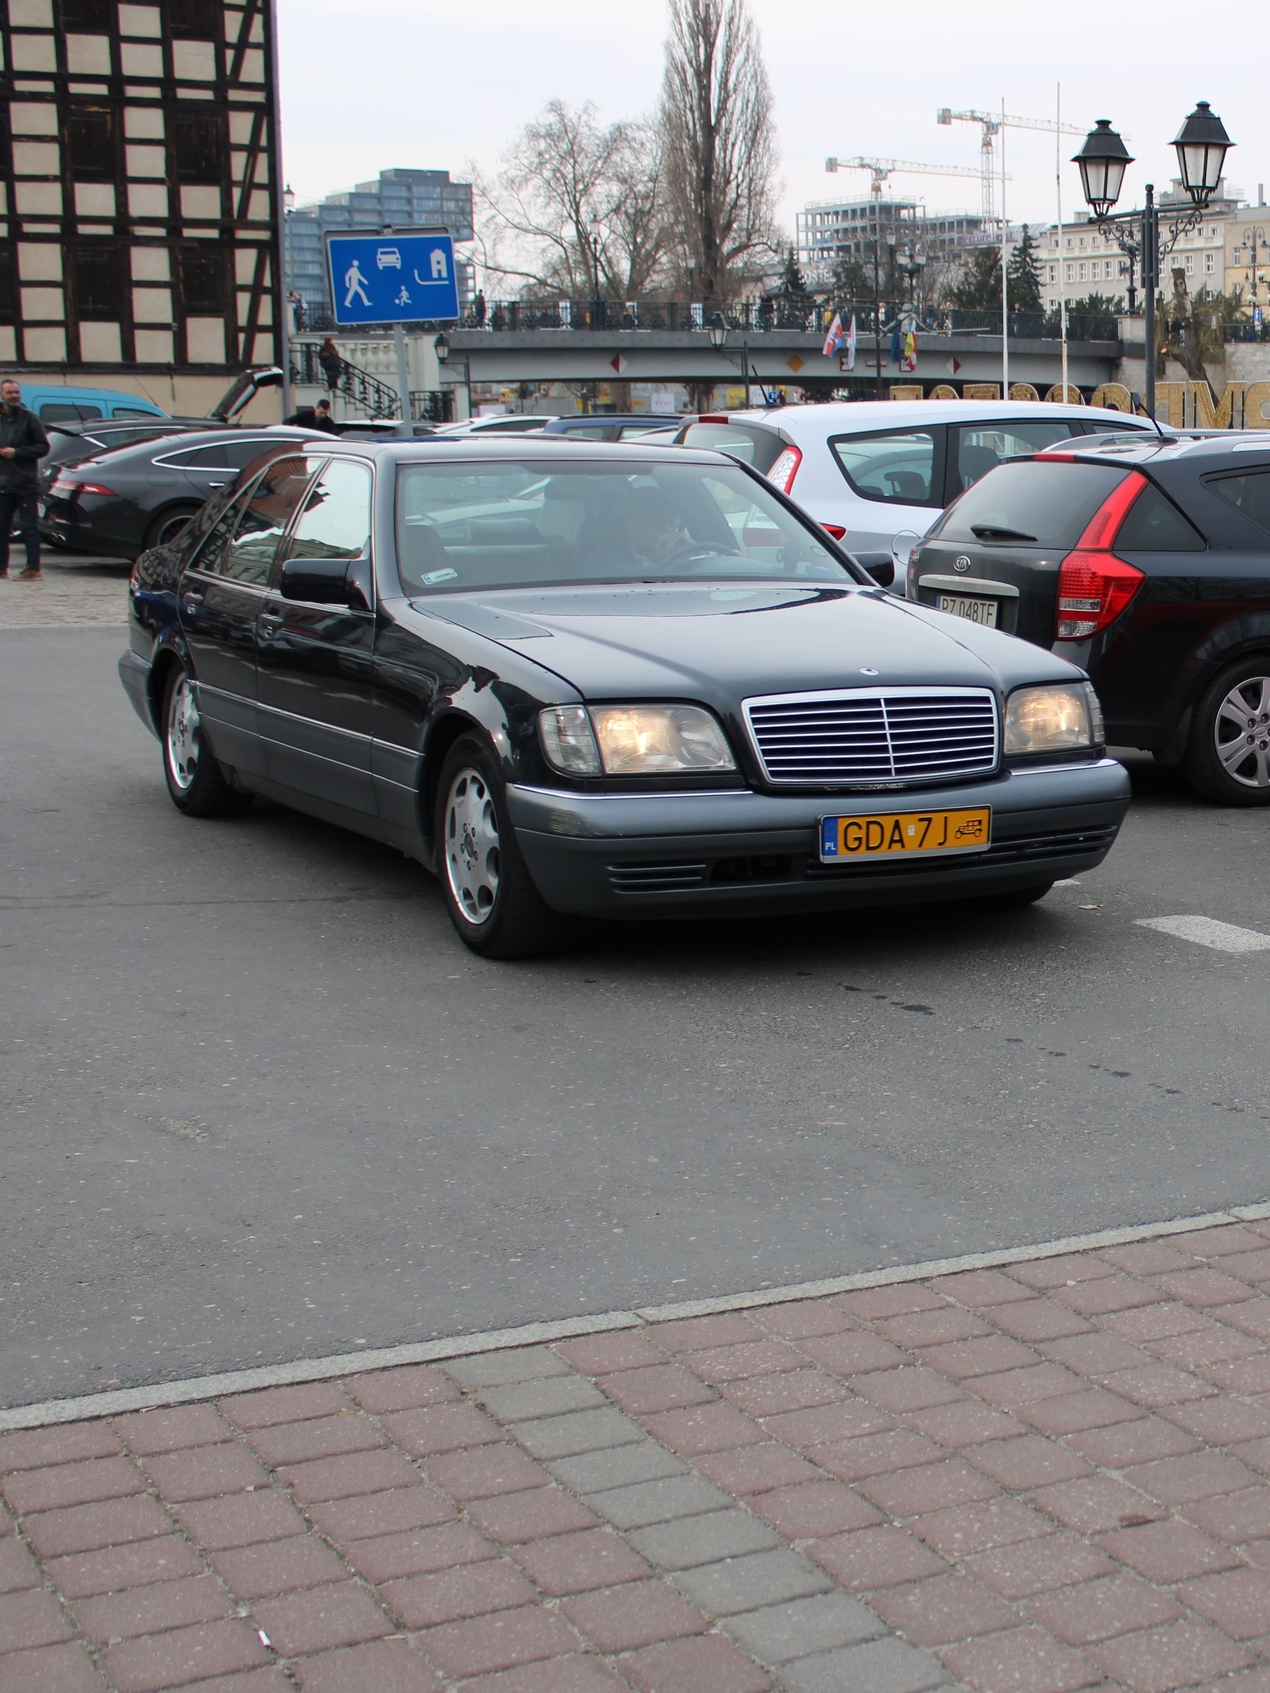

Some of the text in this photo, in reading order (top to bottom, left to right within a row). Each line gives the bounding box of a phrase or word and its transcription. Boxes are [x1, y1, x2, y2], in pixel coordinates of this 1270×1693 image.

[843, 816, 948, 851] GDA 7J
[825, 842, 836, 851] PL
